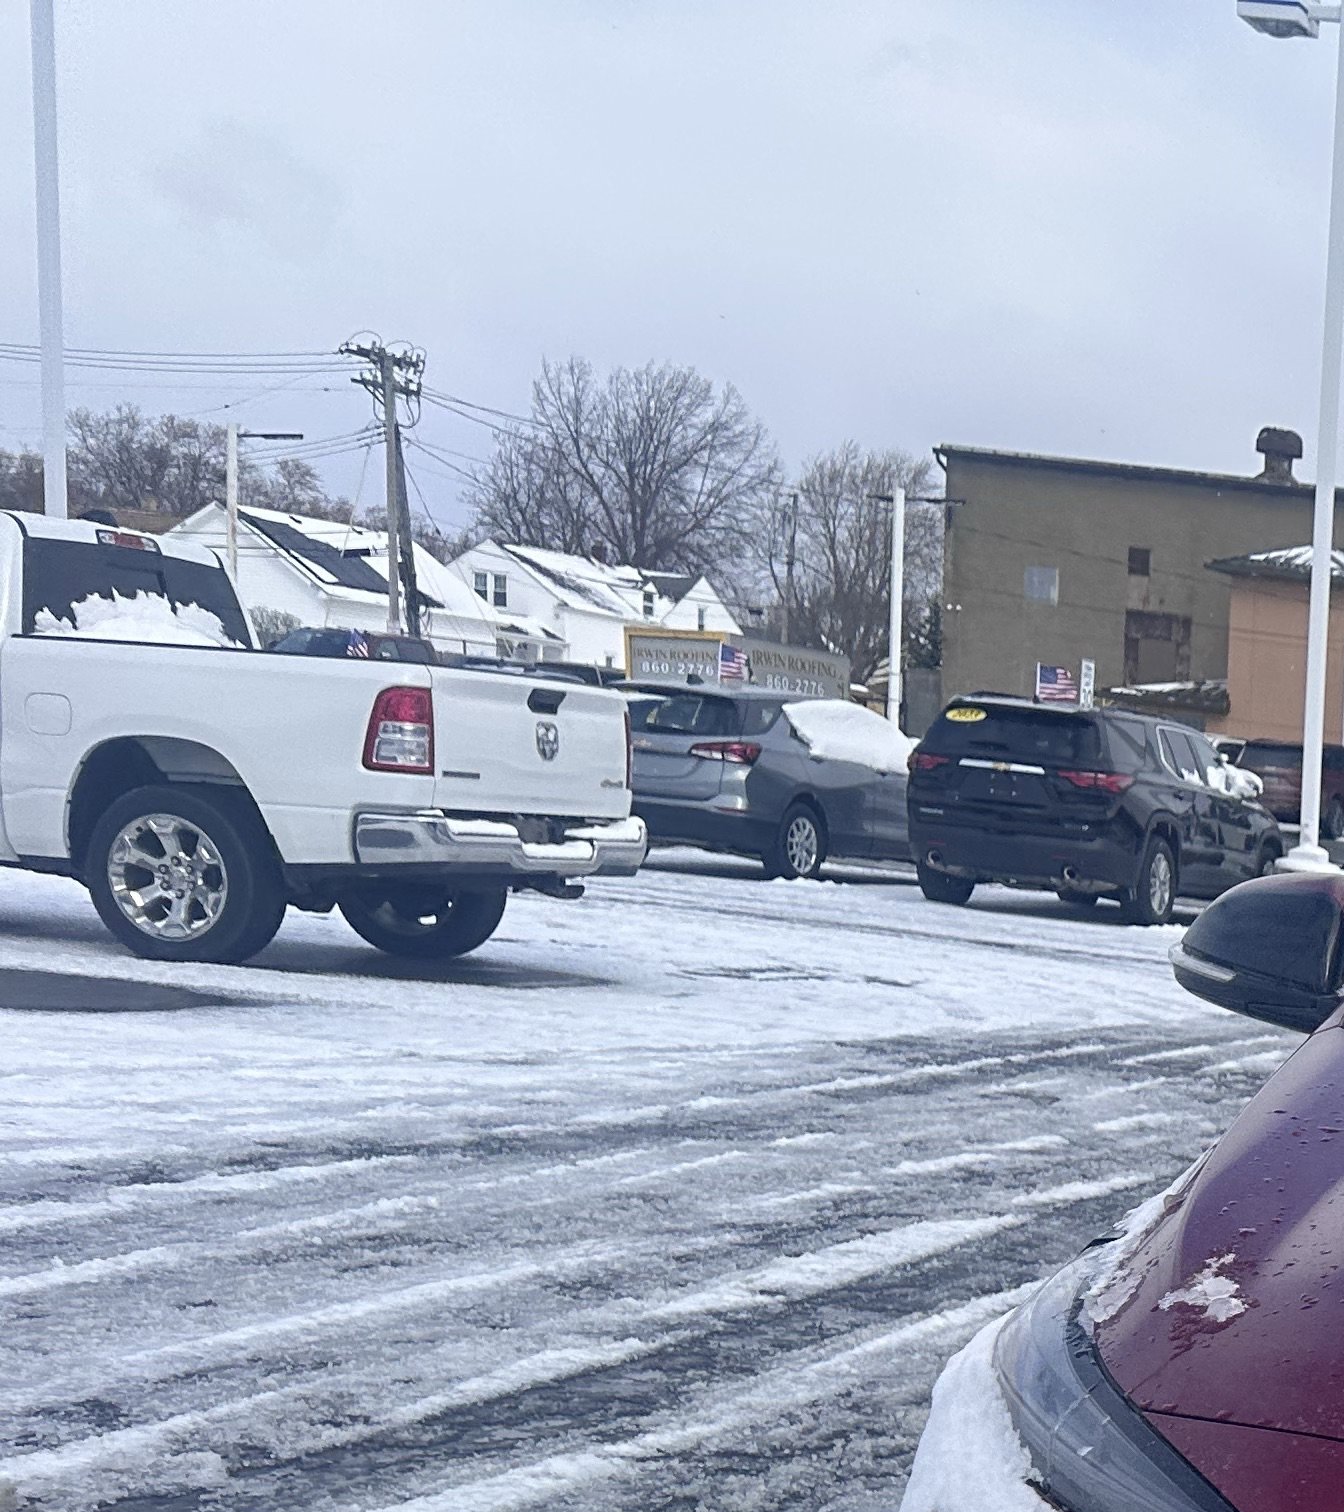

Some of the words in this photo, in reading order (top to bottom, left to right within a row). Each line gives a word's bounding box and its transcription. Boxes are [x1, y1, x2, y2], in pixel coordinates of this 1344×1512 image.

[633, 646, 668, 660] IRWIN
[752, 649, 786, 668] IRWIN
[787, 655, 837, 678] ROOFING
[766, 673, 825, 697] 860-2776
